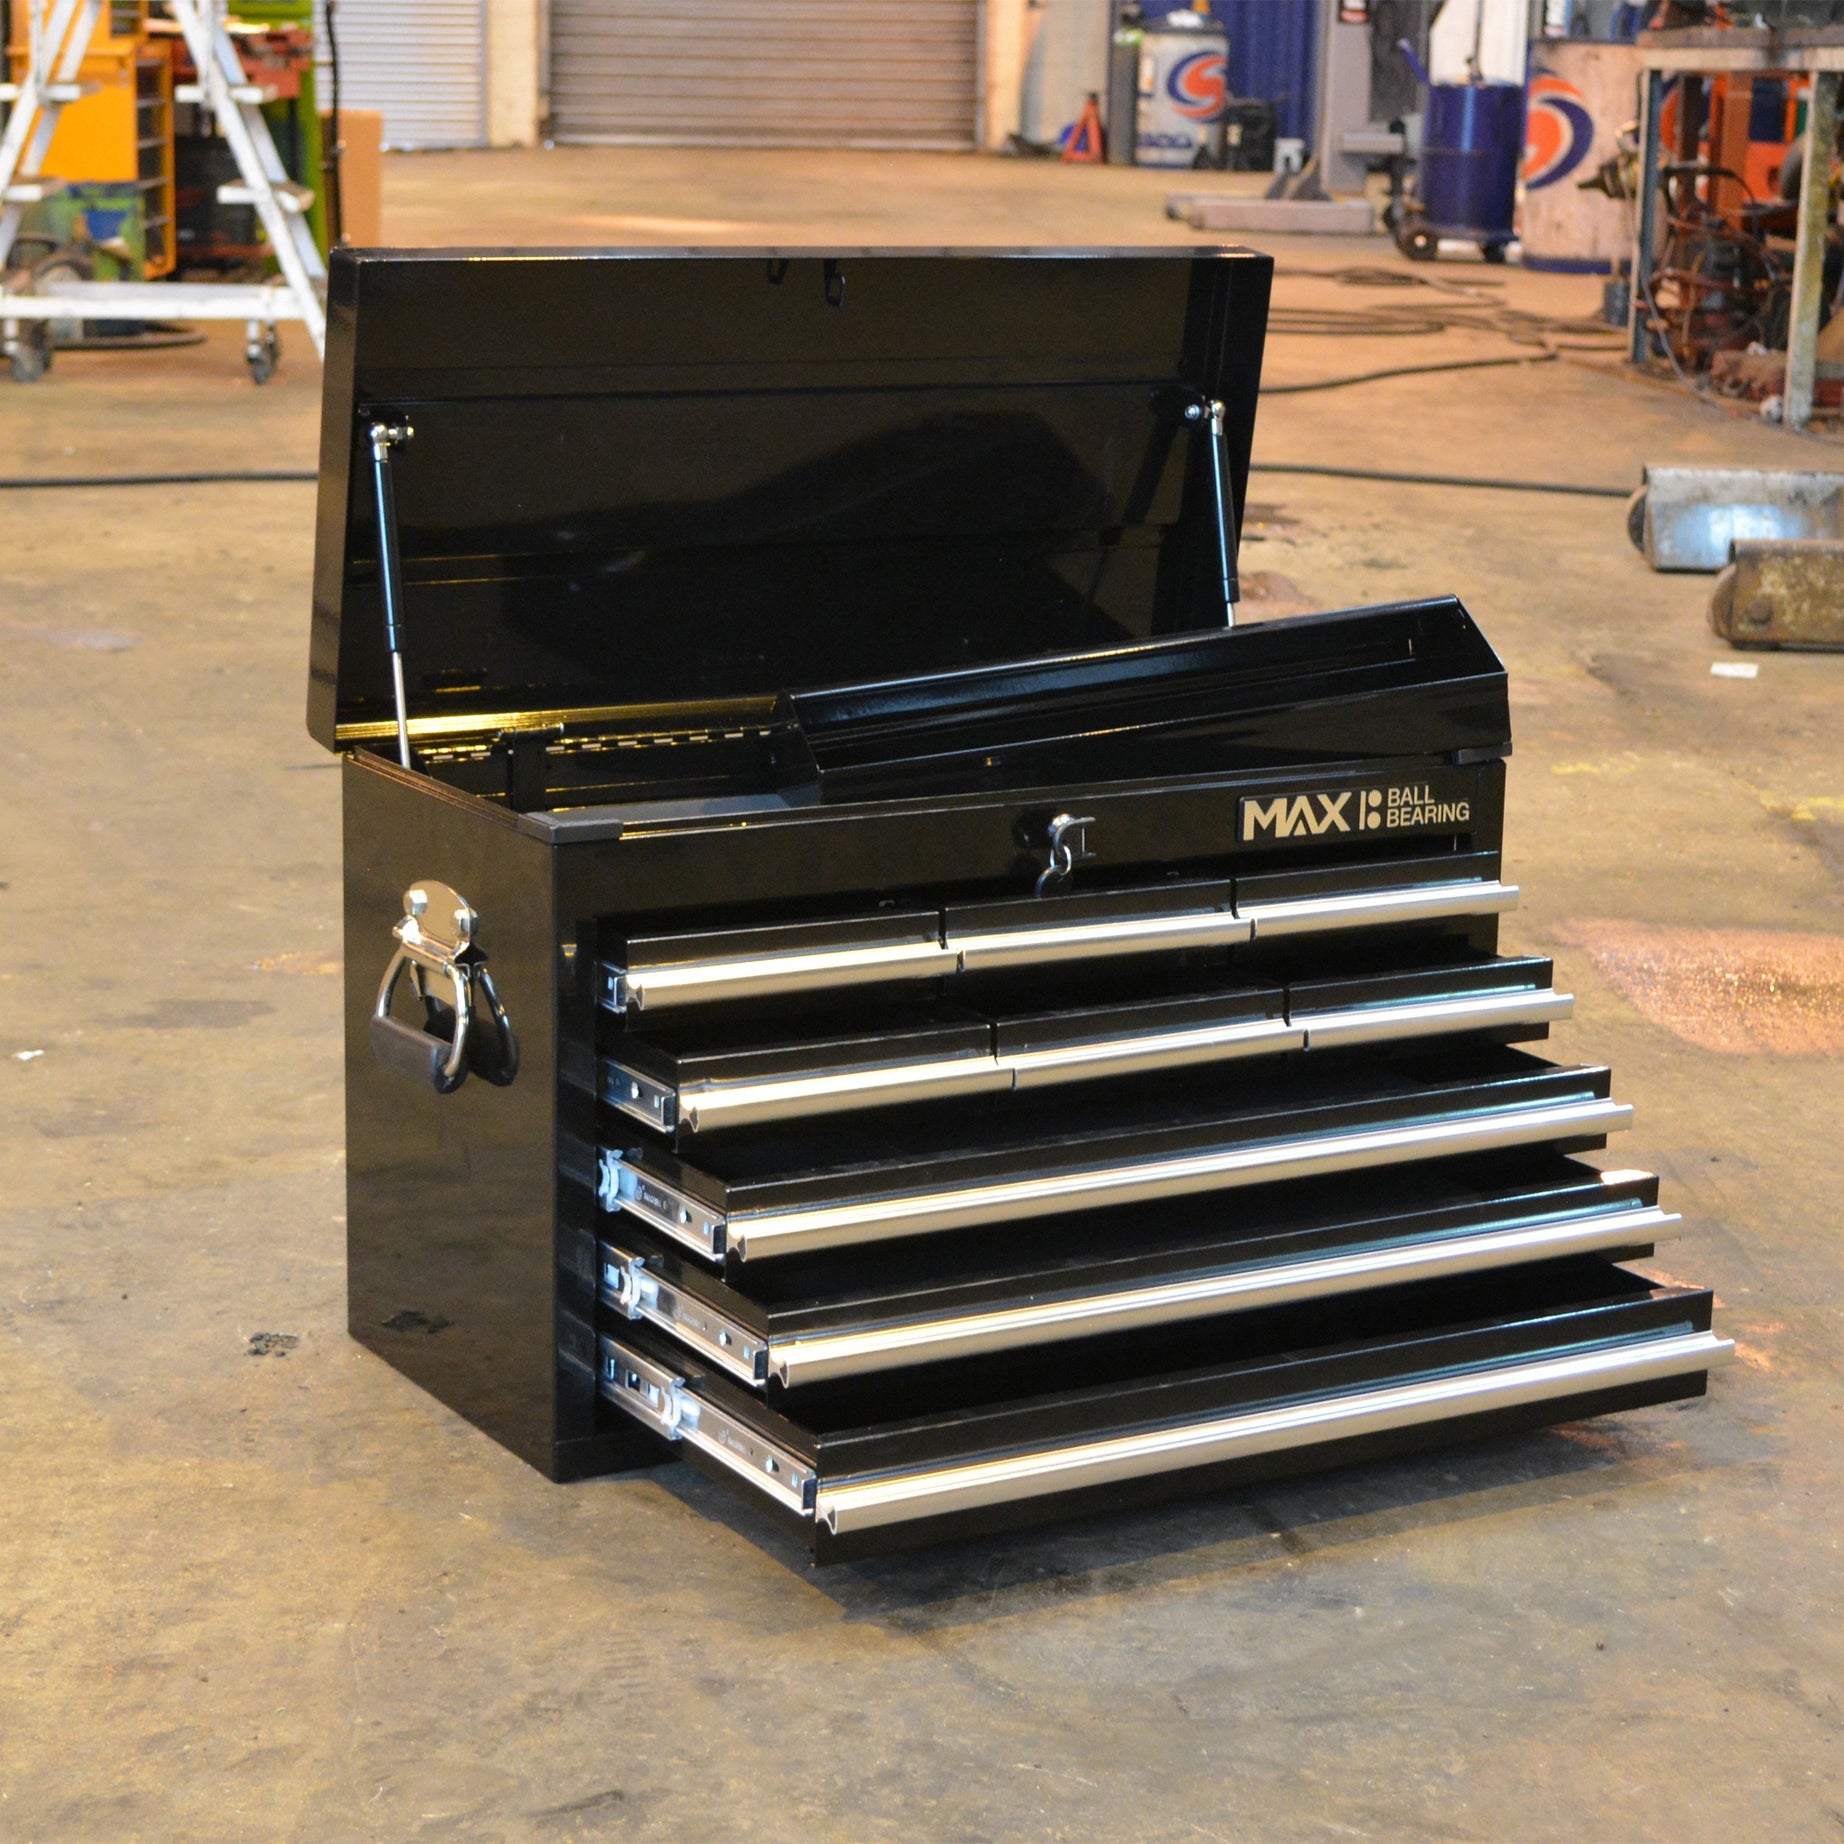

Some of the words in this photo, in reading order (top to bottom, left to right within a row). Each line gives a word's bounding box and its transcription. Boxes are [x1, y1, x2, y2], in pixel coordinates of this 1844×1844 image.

[1387, 785, 1435, 808] BALL
[1243, 792, 1352, 841] MAX
[1386, 802, 1470, 828] BEARING
